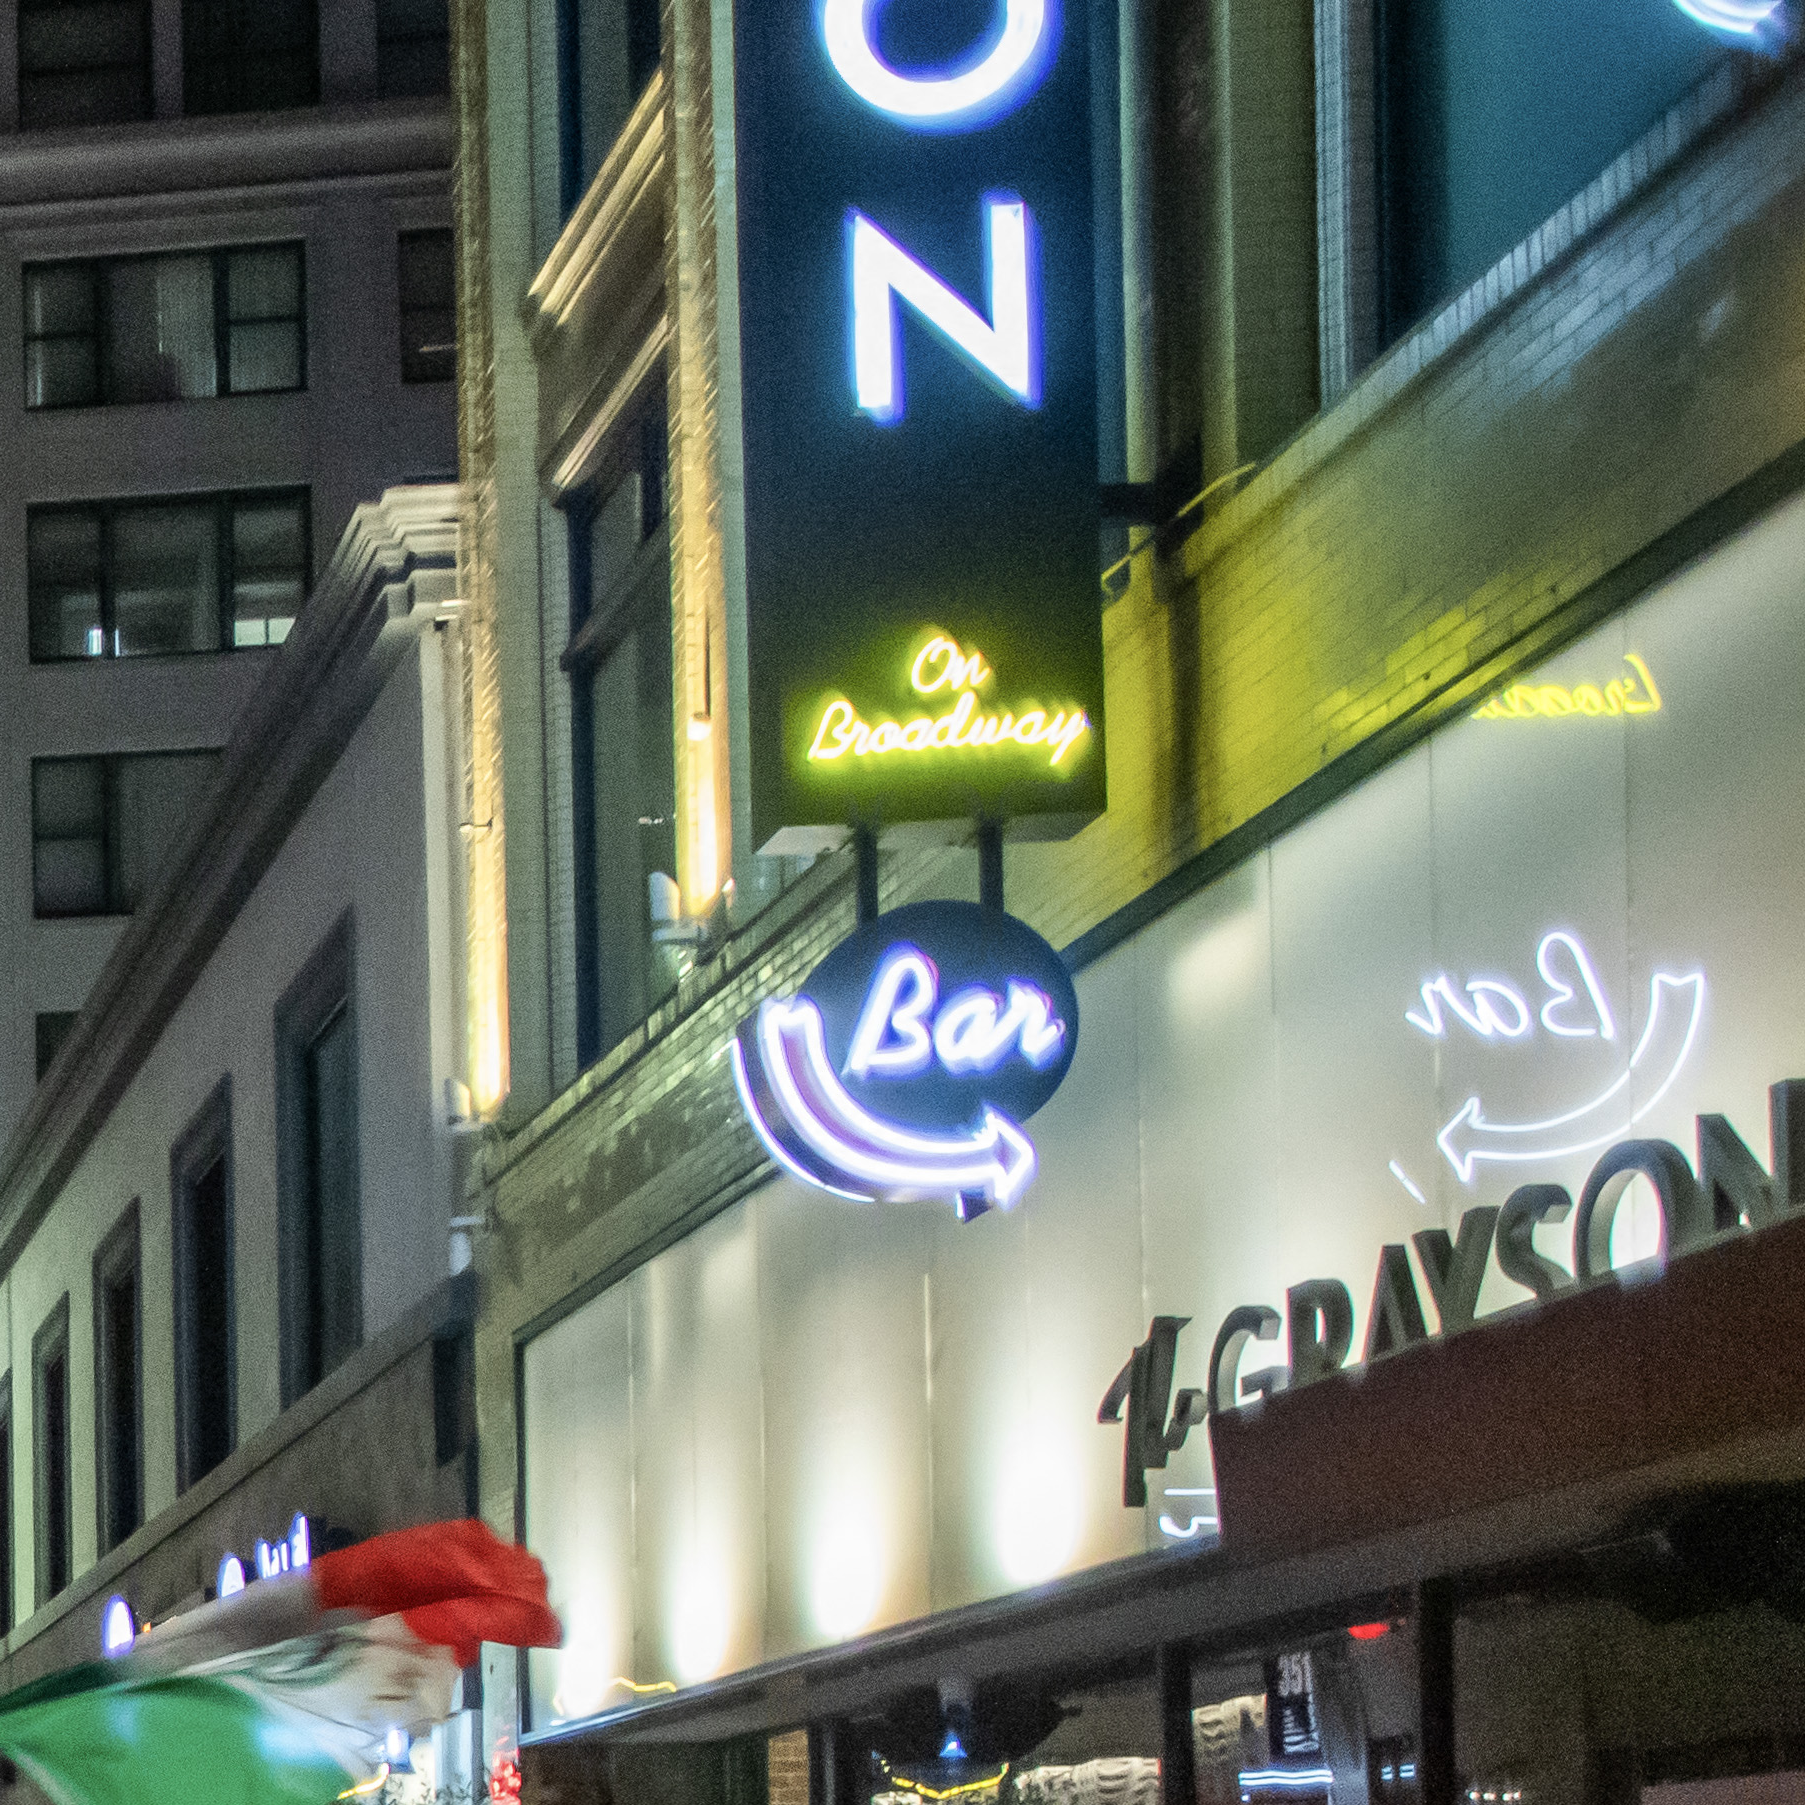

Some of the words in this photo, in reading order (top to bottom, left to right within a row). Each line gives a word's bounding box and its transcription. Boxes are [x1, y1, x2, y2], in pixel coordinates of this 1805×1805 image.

[910, 634, 990, 694] On
[807, 692, 1089, 768] Broadway
[842, 948, 1064, 1075] Bar
[1207, 1078, 1805, 1416] GRAYSON
